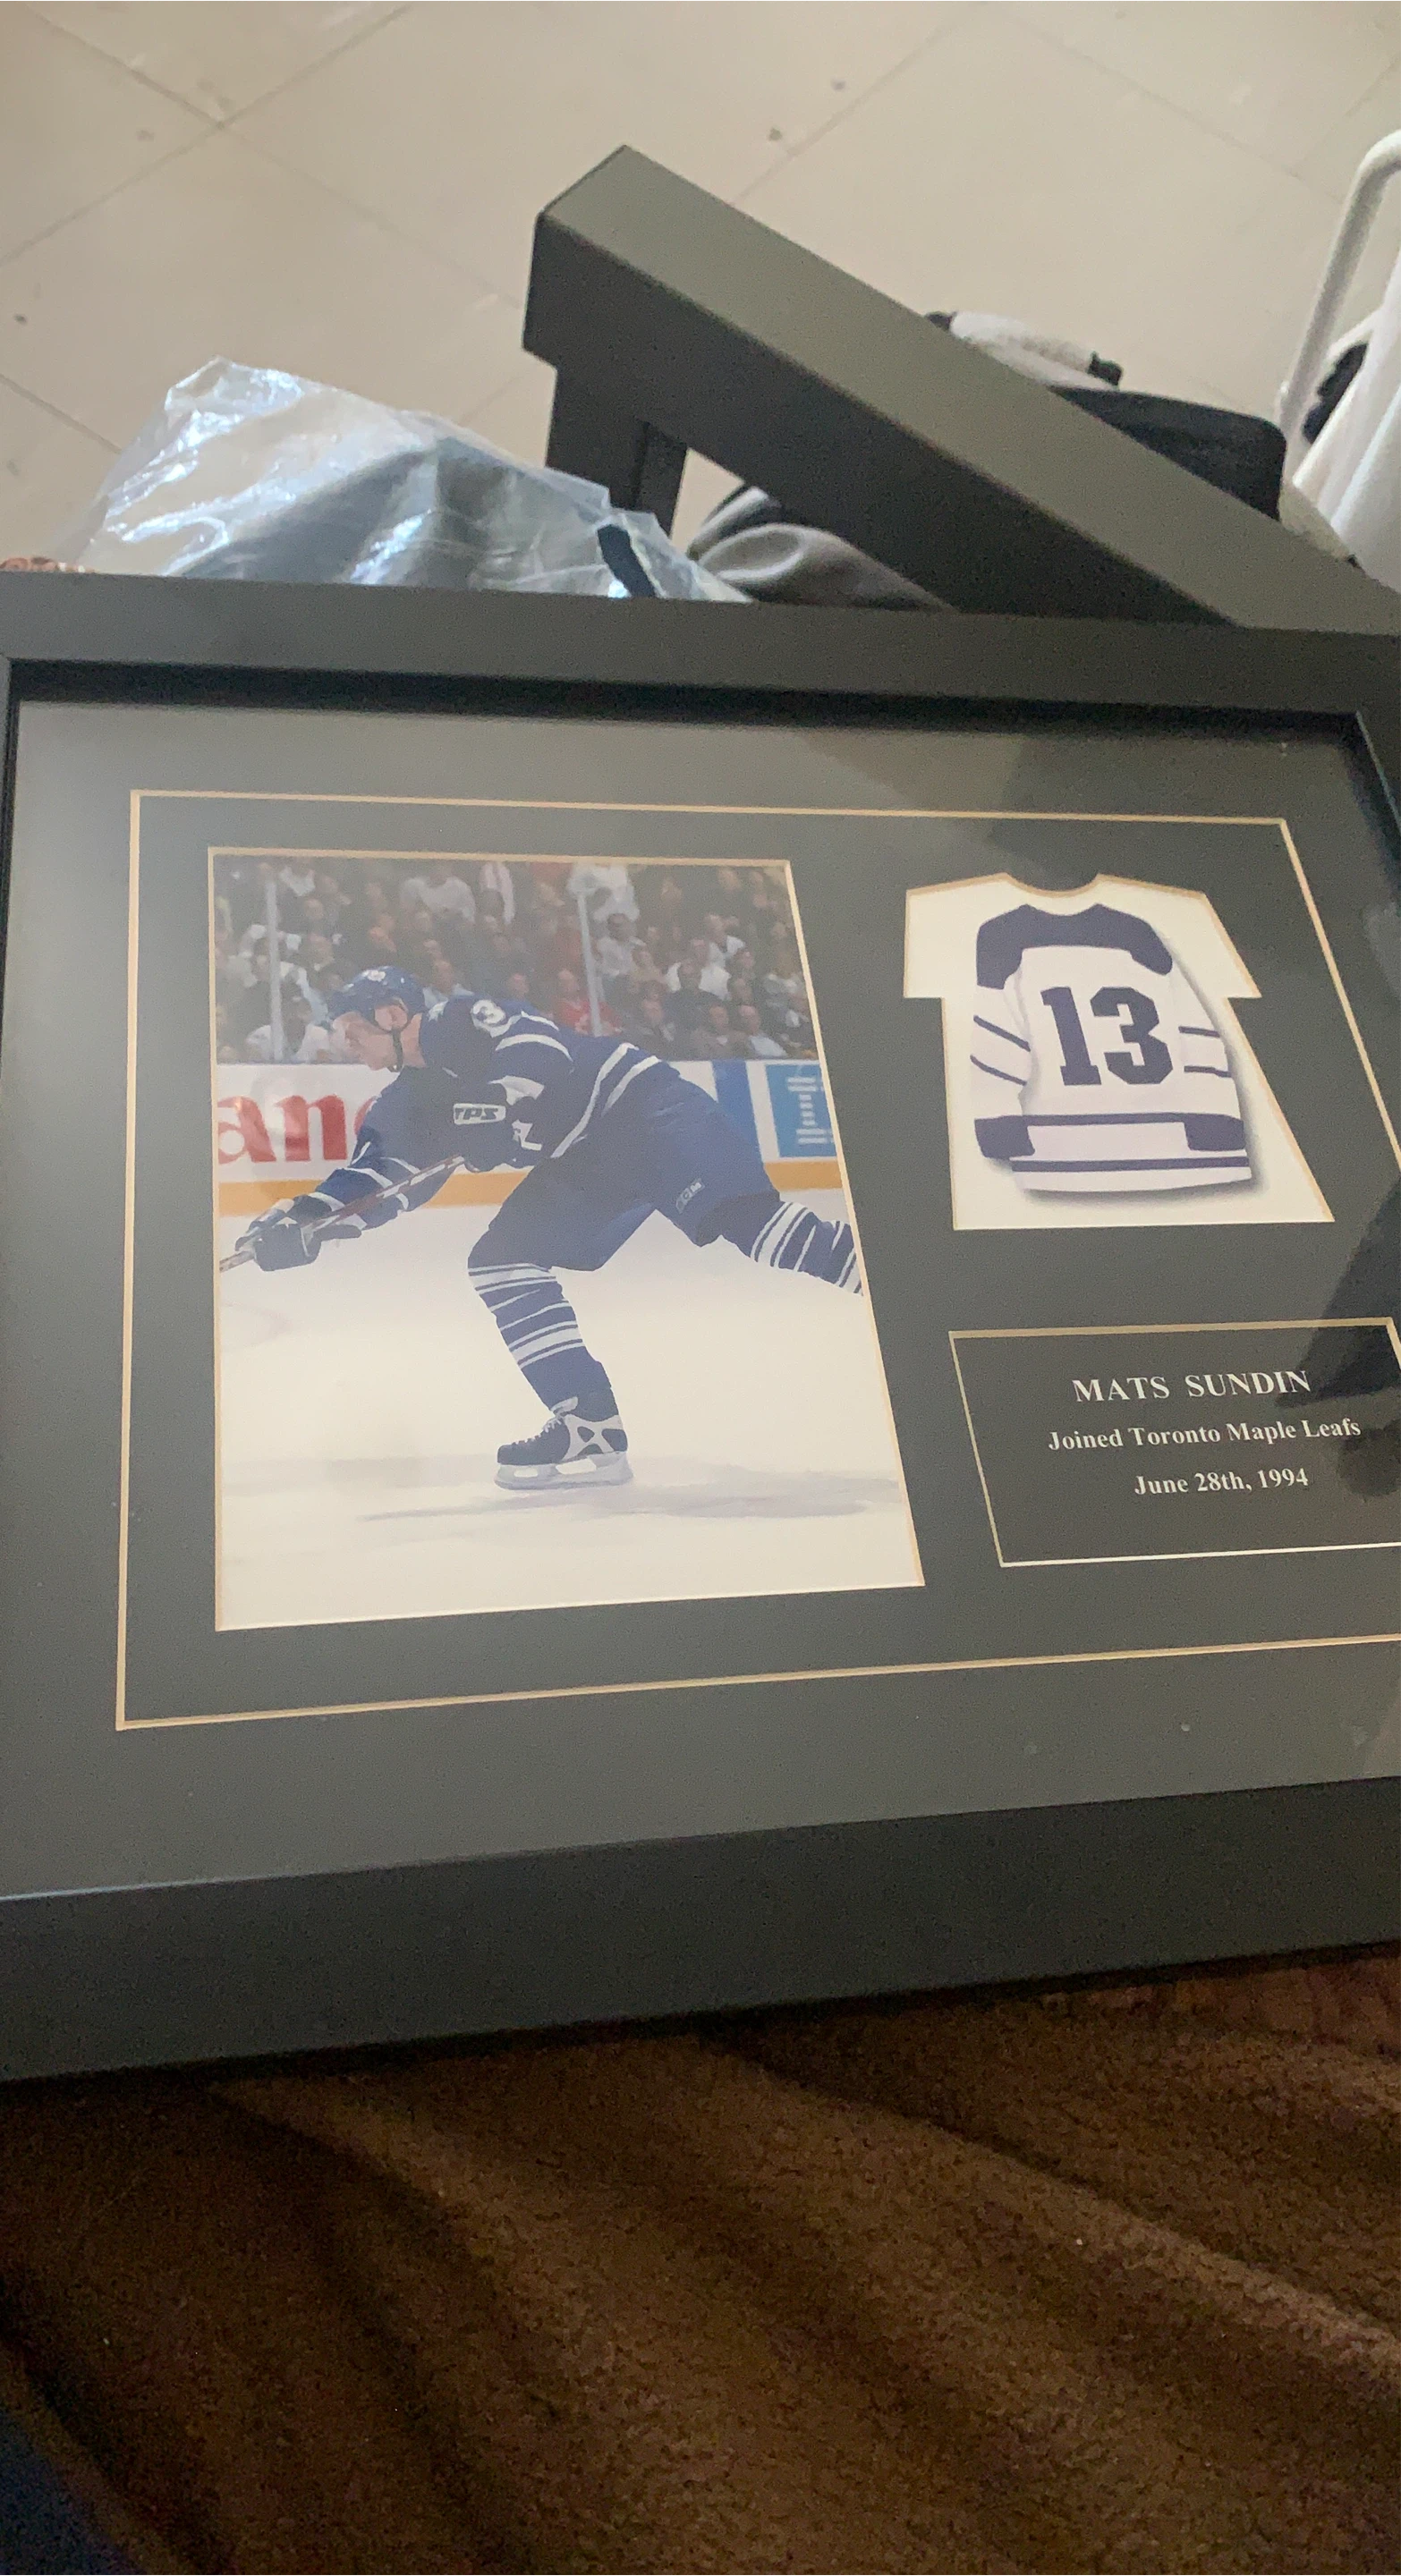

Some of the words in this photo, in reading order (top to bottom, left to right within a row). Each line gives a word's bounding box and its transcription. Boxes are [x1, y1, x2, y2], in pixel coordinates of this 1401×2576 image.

[1040, 986, 1174, 1087] 13
[217, 1094, 380, 1165] an
[1072, 1376, 1170, 1402] MATS
[1184, 1369, 1311, 1397] SUNDIN
[1048, 1428, 1124, 1451] Joined
[1127, 1426, 1221, 1446] Toronto
[1226, 1420, 1296, 1445] Maple
[1301, 1417, 1362, 1439] Leafs
[1134, 1475, 1189, 1496] June
[1193, 1470, 1252, 1492] 28th,
[1257, 1467, 1309, 1488] 1994
